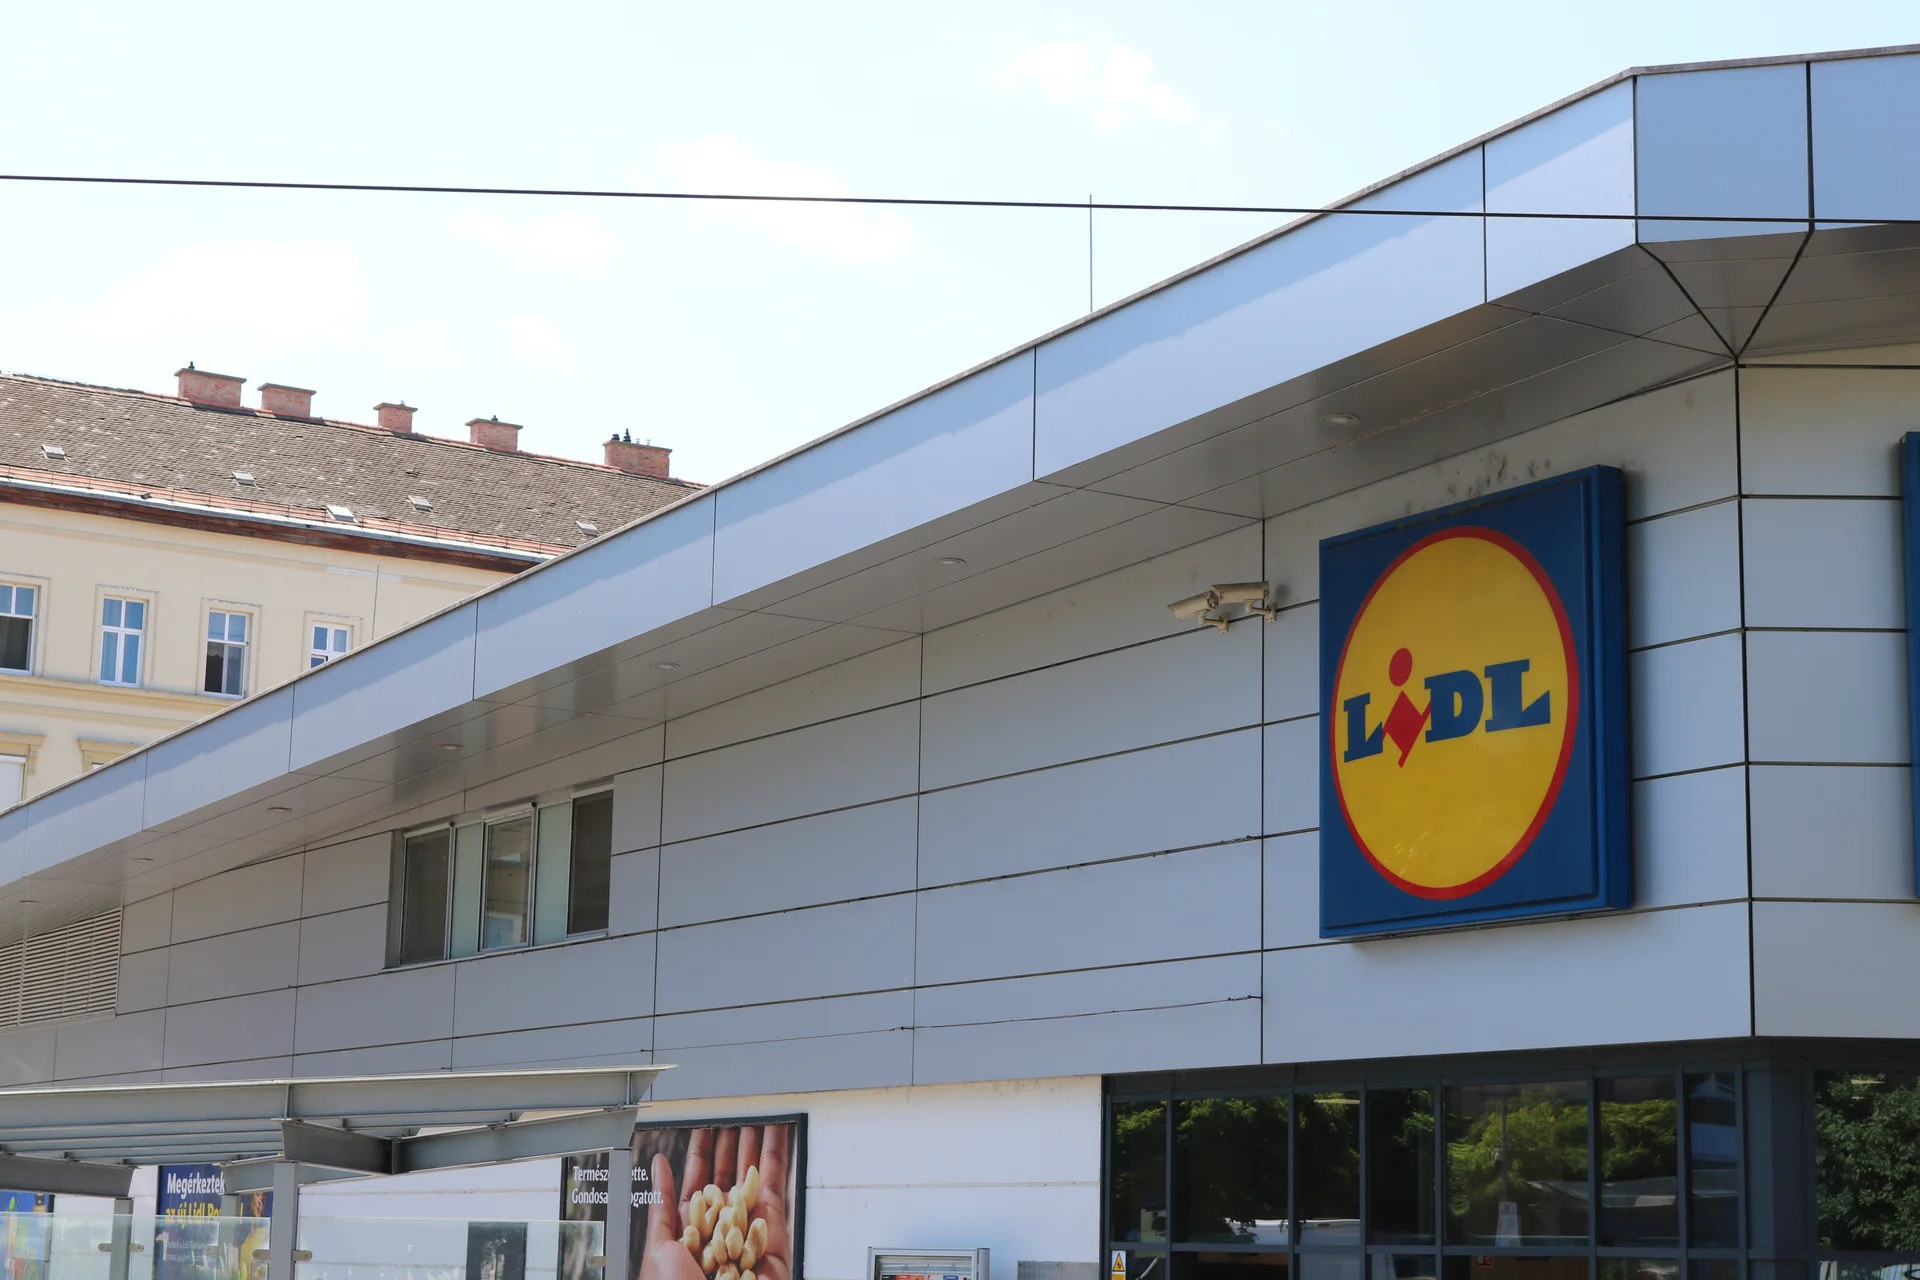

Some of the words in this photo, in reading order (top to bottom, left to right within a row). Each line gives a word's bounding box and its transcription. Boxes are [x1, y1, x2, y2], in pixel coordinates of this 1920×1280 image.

[573, 1165, 609, 1181] Termész
[167, 1172, 225, 1199] Megérkeztek
[572, 1187, 608, 1204] Gondosa
